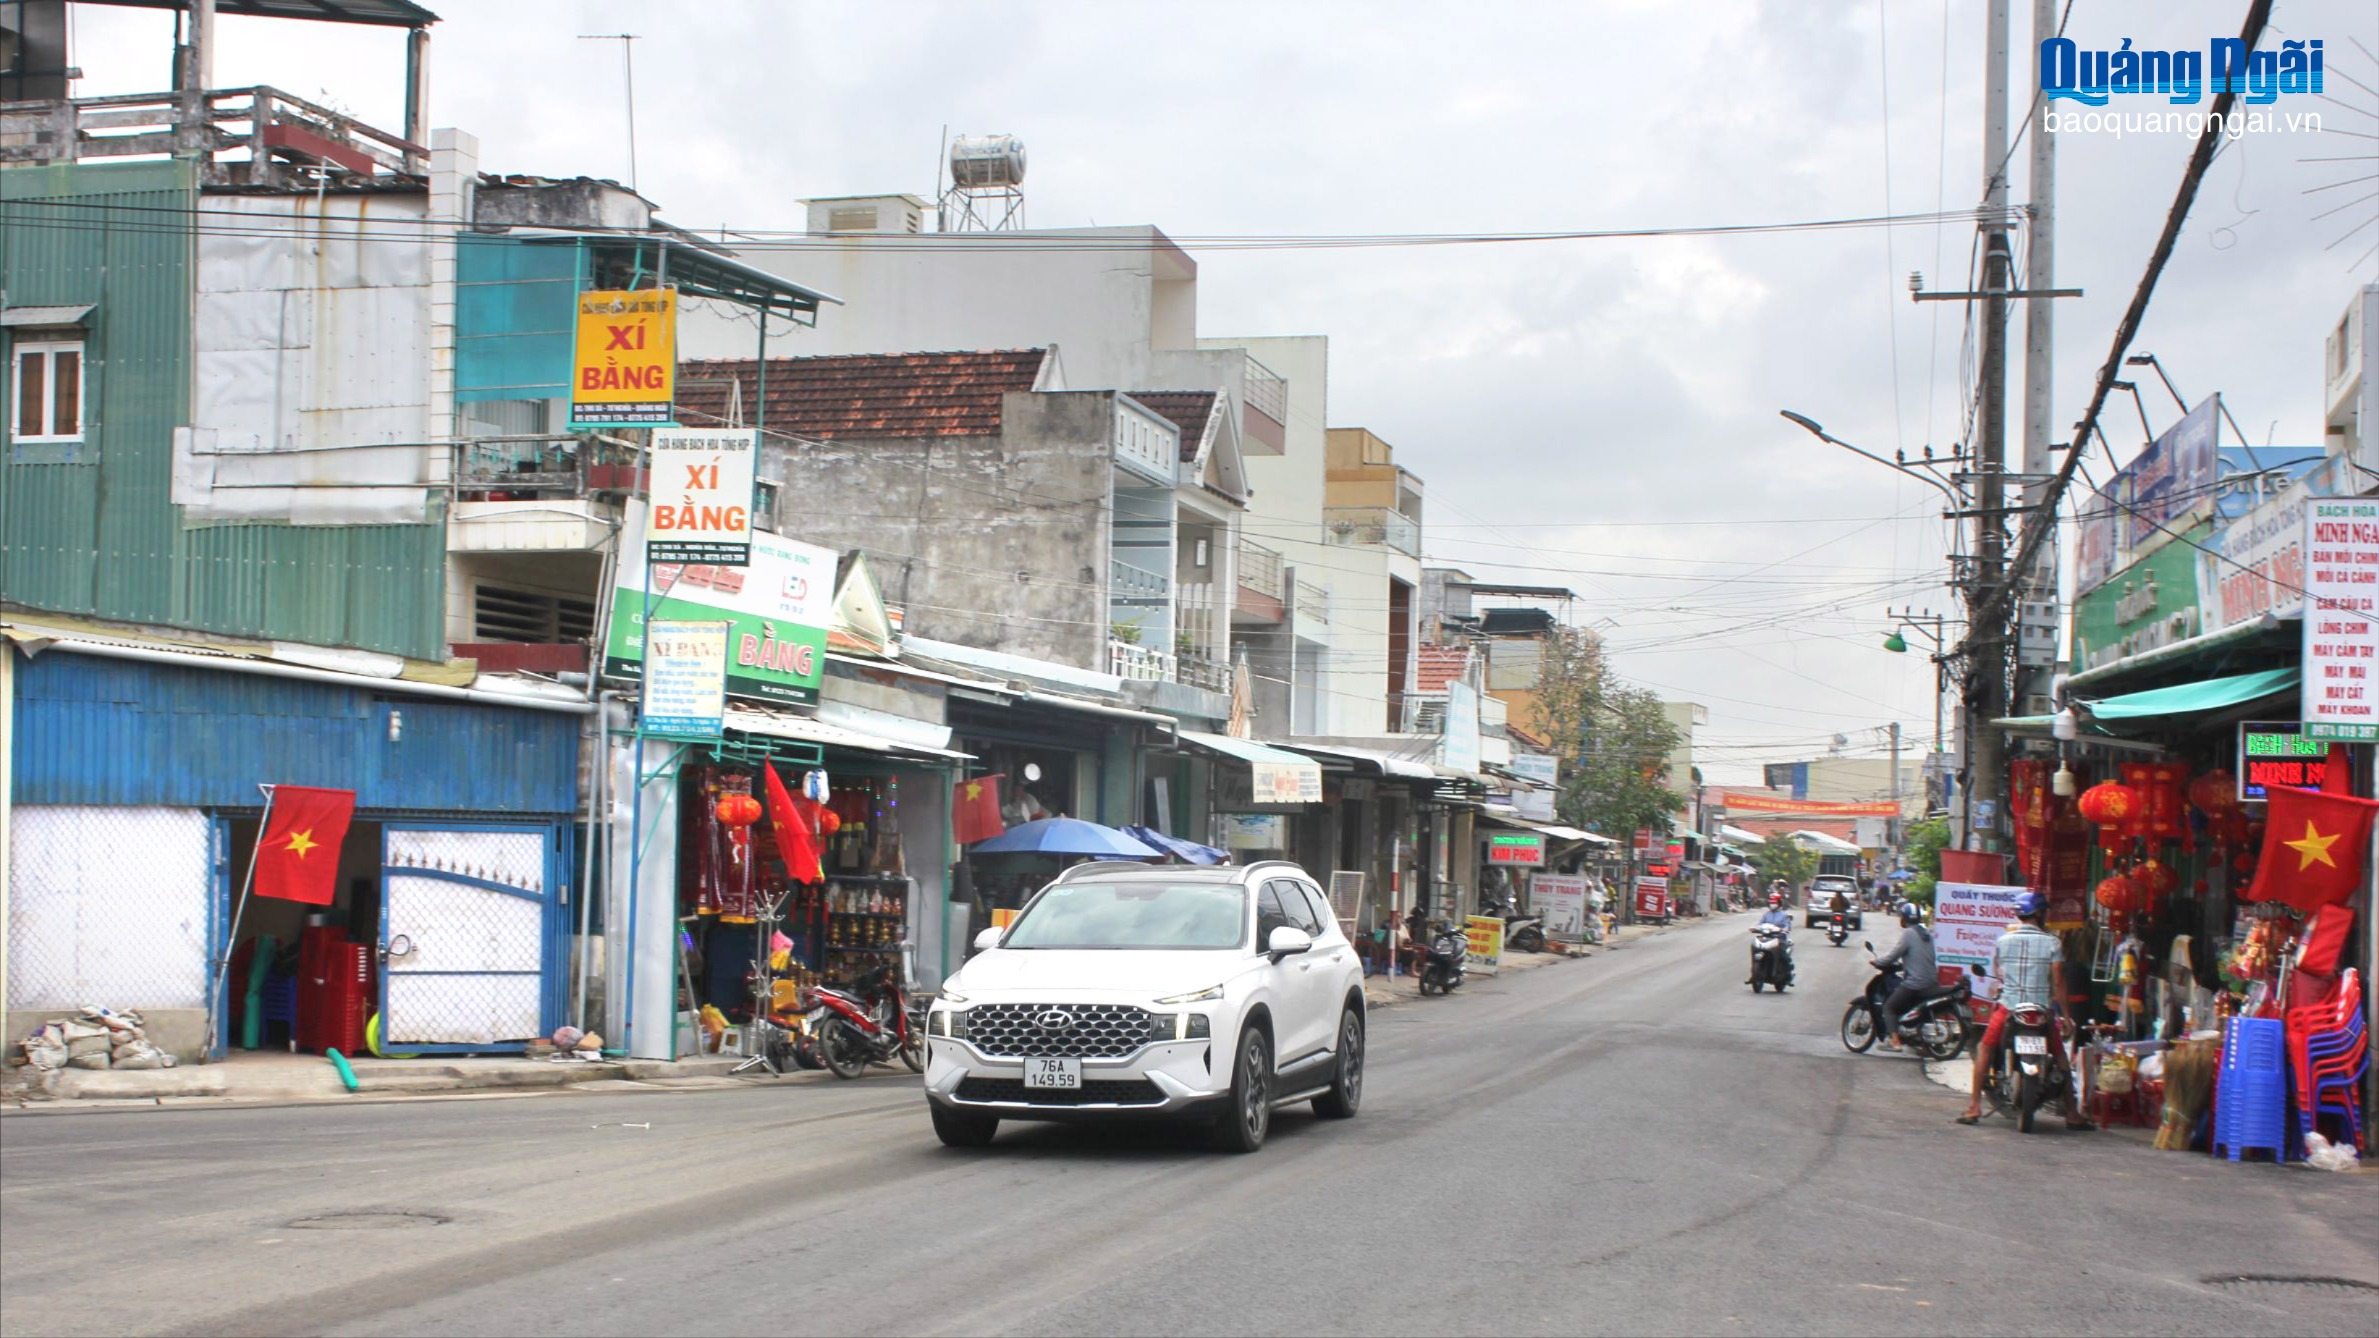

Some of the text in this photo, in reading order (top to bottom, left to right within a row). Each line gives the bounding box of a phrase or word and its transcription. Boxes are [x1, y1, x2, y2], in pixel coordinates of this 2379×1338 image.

[604, 317, 648, 351] XÍ
[580, 356, 665, 391] BẰNG
[685, 455, 721, 490] XÍ
[654, 495, 746, 532] BẰNG
[2315, 523, 2349, 543] MINH
[2344, 622, 2369, 634] CHIM
[738, 621, 814, 677] BẰNG
[2360, 645, 2375, 657] TAY
[2340, 705, 2371, 715] KHOAN
[2249, 761, 2303, 784] MINH
[1940, 902, 1976, 917] QUANG
[1041, 1060, 1065, 1072] 76A
[1032, 1074, 1075, 1087] 149.59
